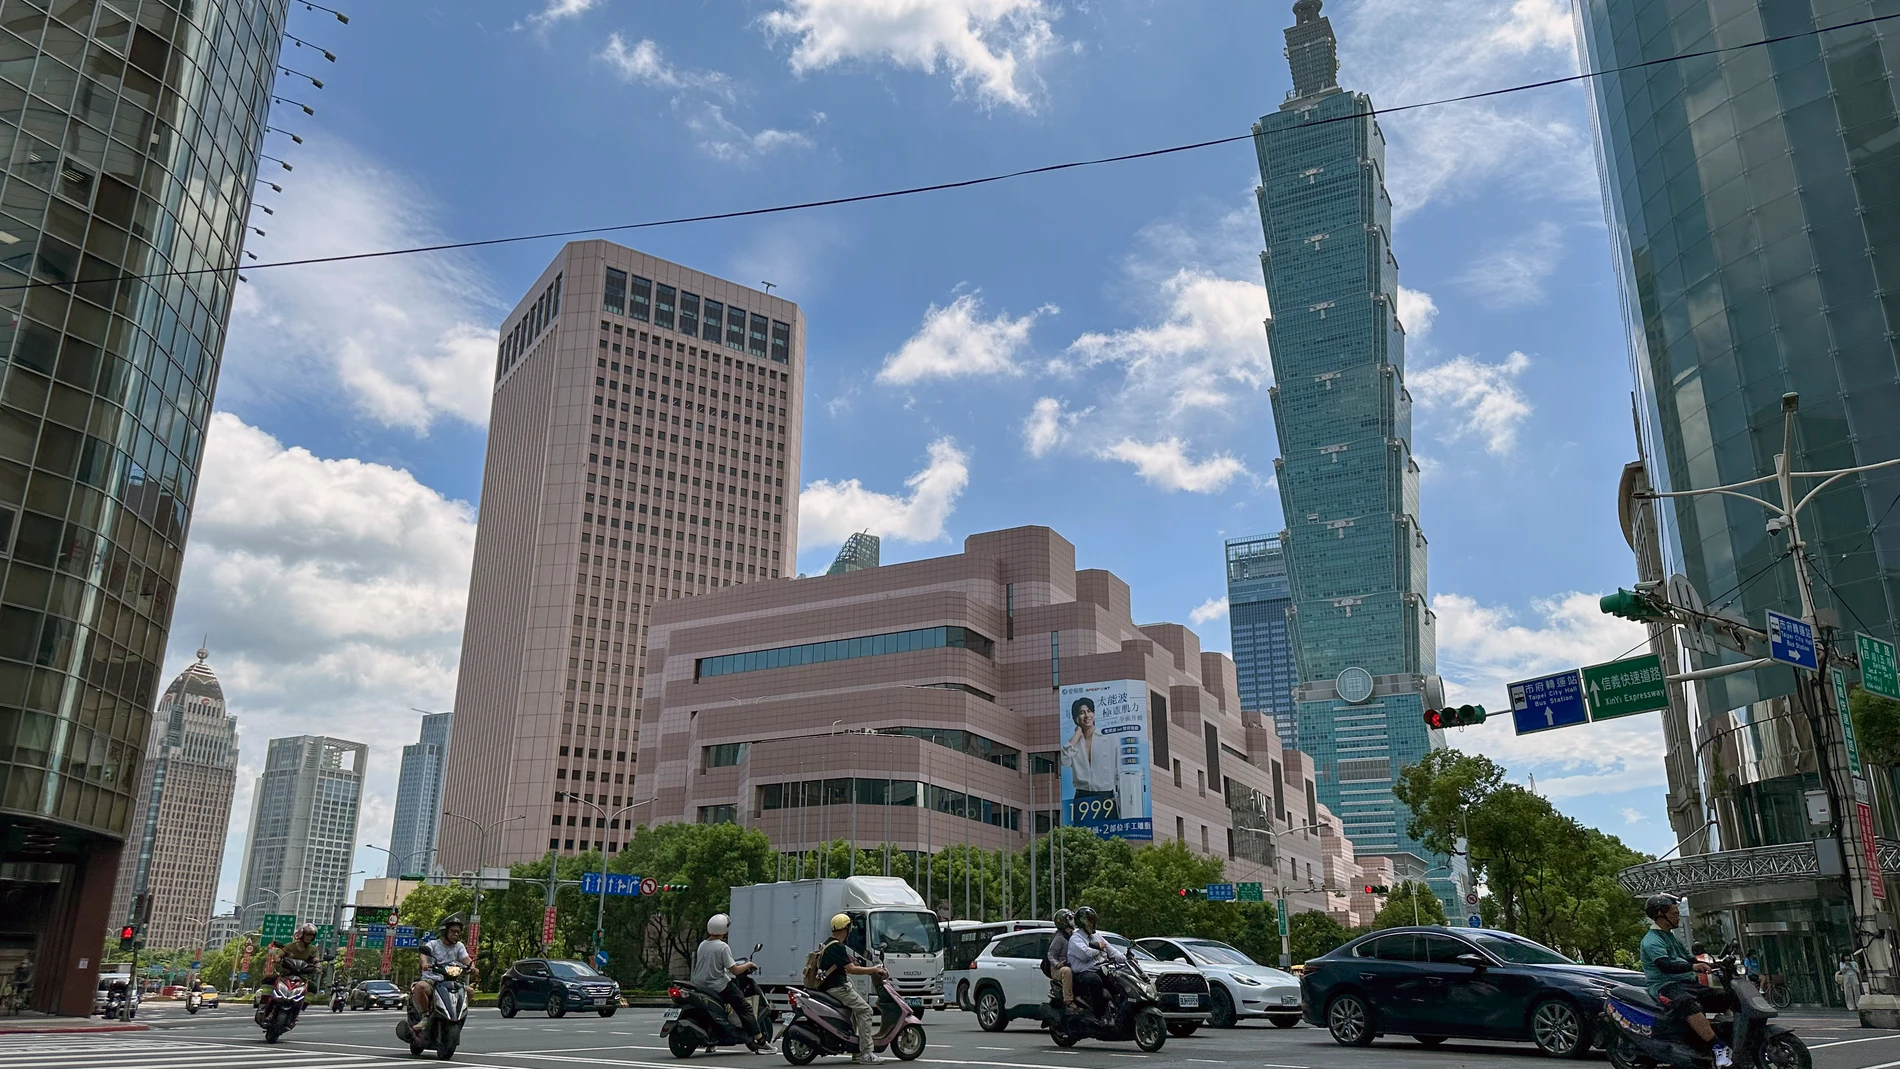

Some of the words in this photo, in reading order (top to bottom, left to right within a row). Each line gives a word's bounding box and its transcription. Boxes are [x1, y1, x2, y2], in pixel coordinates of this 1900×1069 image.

[1781, 630, 1793, 640] Taipei
[1794, 634, 1804, 643] City
[1787, 640, 1795, 648] Bus
[1795, 642, 1810, 652] Station
[1525, 674, 1578, 694] 市府轉運站
[1601, 666, 1662, 691] 信義快速道路
[1098, 692, 1128, 708] 太能波
[1528, 692, 1547, 701] Taipei
[1549, 689, 1563, 697] City
[1550, 695, 1574, 704] Station
[1605, 695, 1623, 706] XinYi
[1624, 688, 1665, 703] Expressway
[1069, 799, 1114, 821] 1999
